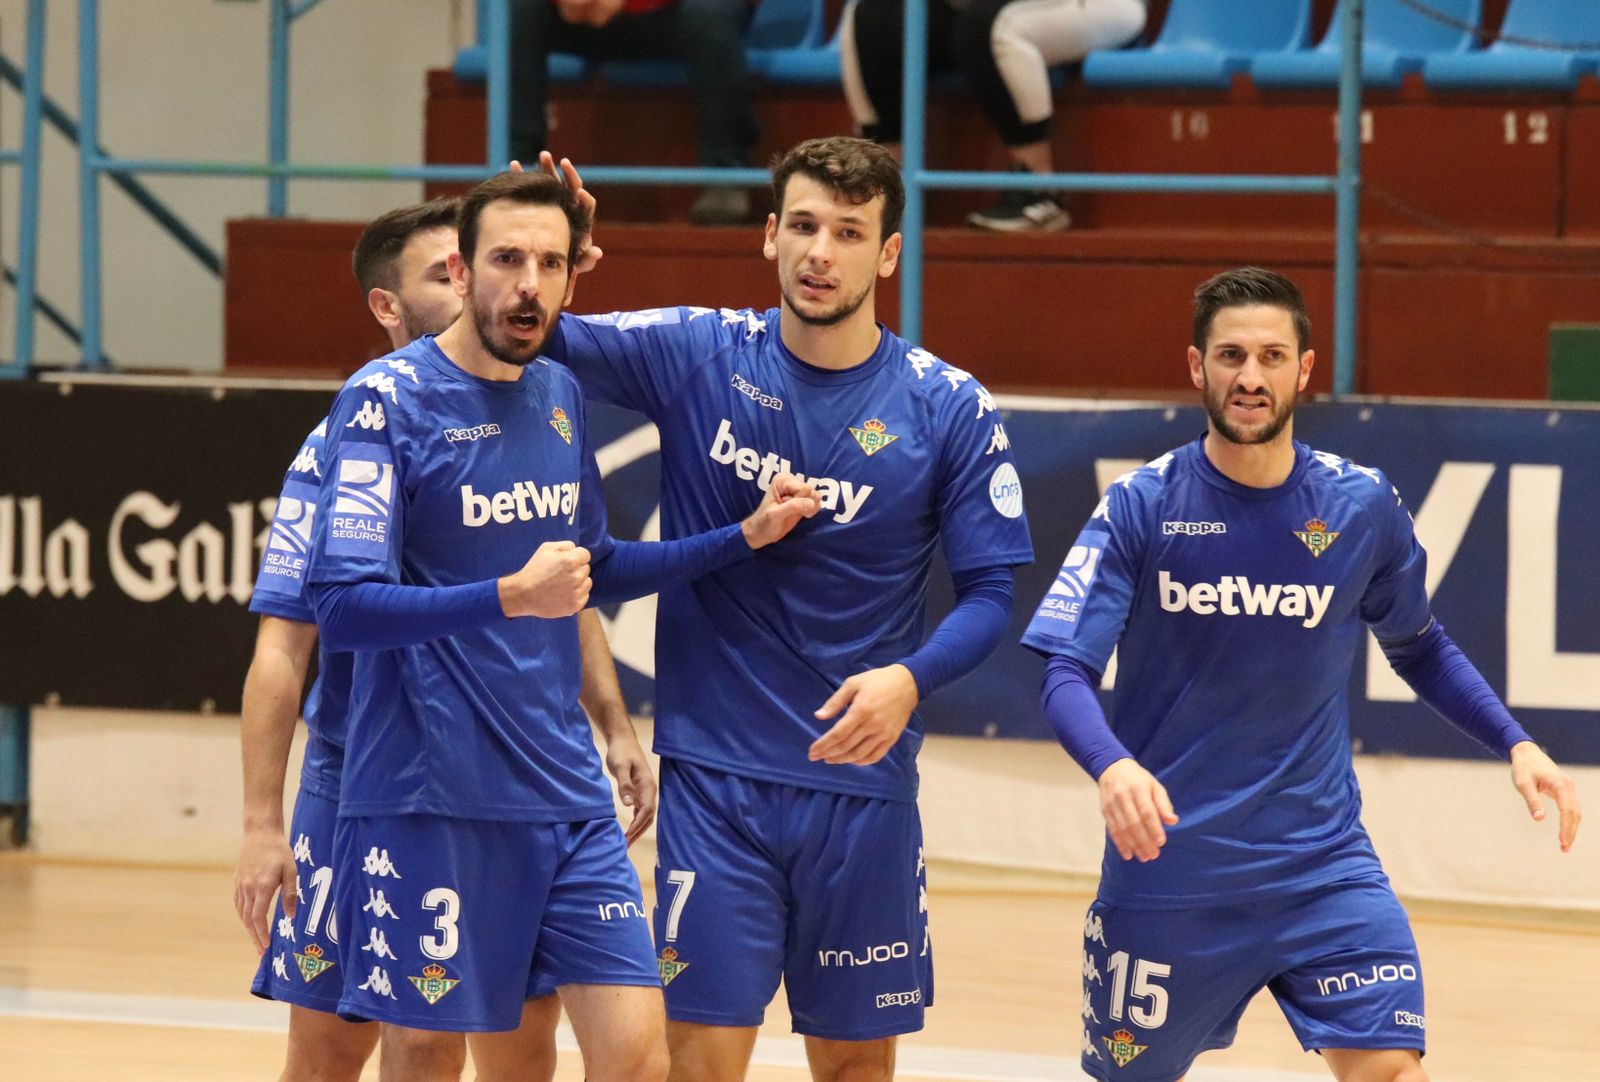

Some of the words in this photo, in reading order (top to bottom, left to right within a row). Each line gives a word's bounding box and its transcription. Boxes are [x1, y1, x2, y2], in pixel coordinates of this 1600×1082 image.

[1503, 110, 1548, 145] 12
[731, 373, 783, 411] Kappa
[444, 424, 501, 442] Kappa
[461, 480, 580, 527] betway
[332, 530, 385, 543] SEGUROS
[333, 518, 386, 533] REALE
[1162, 521, 1226, 536] Kappa
[263, 565, 301, 579] SEGUROS
[266, 553, 304, 570] REALE
[1041, 598, 1080, 614] REALE
[1158, 570, 1335, 629] betway
[304, 866, 339, 945] 1
[665, 869, 696, 942] 7
[419, 887, 460, 960] 3
[1107, 950, 1171, 1030] 15
